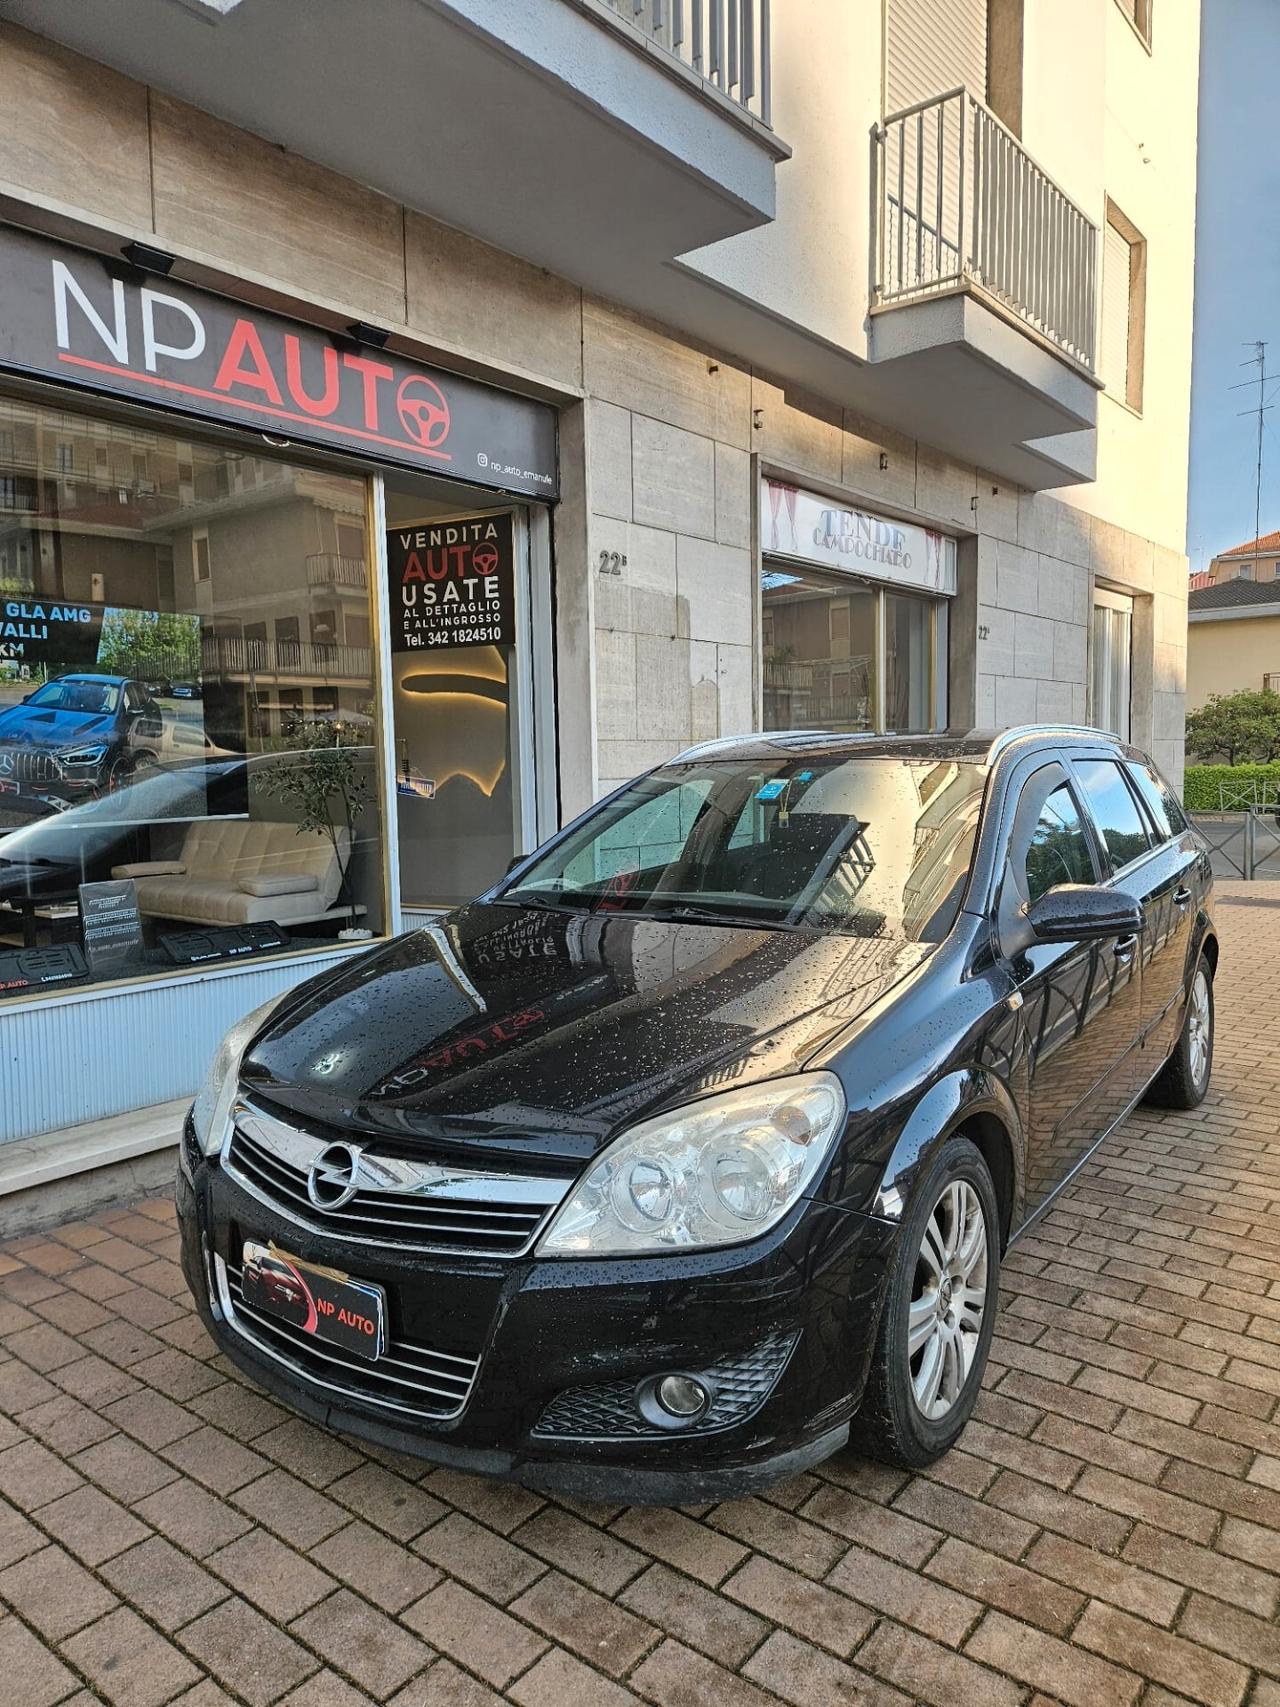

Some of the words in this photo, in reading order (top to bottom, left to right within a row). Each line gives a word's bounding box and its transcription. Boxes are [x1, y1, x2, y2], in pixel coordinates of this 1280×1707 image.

[51, 259, 207, 372] NP
[213, 319, 451, 448] AUTO
[400, 523, 498, 550] VENDITA
[402, 542, 499, 583] AUTO
[402, 576, 500, 607] USATE
[6, 602, 47, 620] GLA
[50, 606, 92, 623] AMG
[403, 608, 419, 619] AL
[426, 600, 501, 616] DETTAGLIO
[403, 621, 410, 630] E
[415, 613, 501, 628] ALL'INGROSSO
[404, 633, 425, 647] Tel.
[427, 631, 449, 645] 342
[452, 627, 501, 643] 1824510
[316, 1297, 336, 1317] NP
[338, 1309, 376, 1336] AUTO
